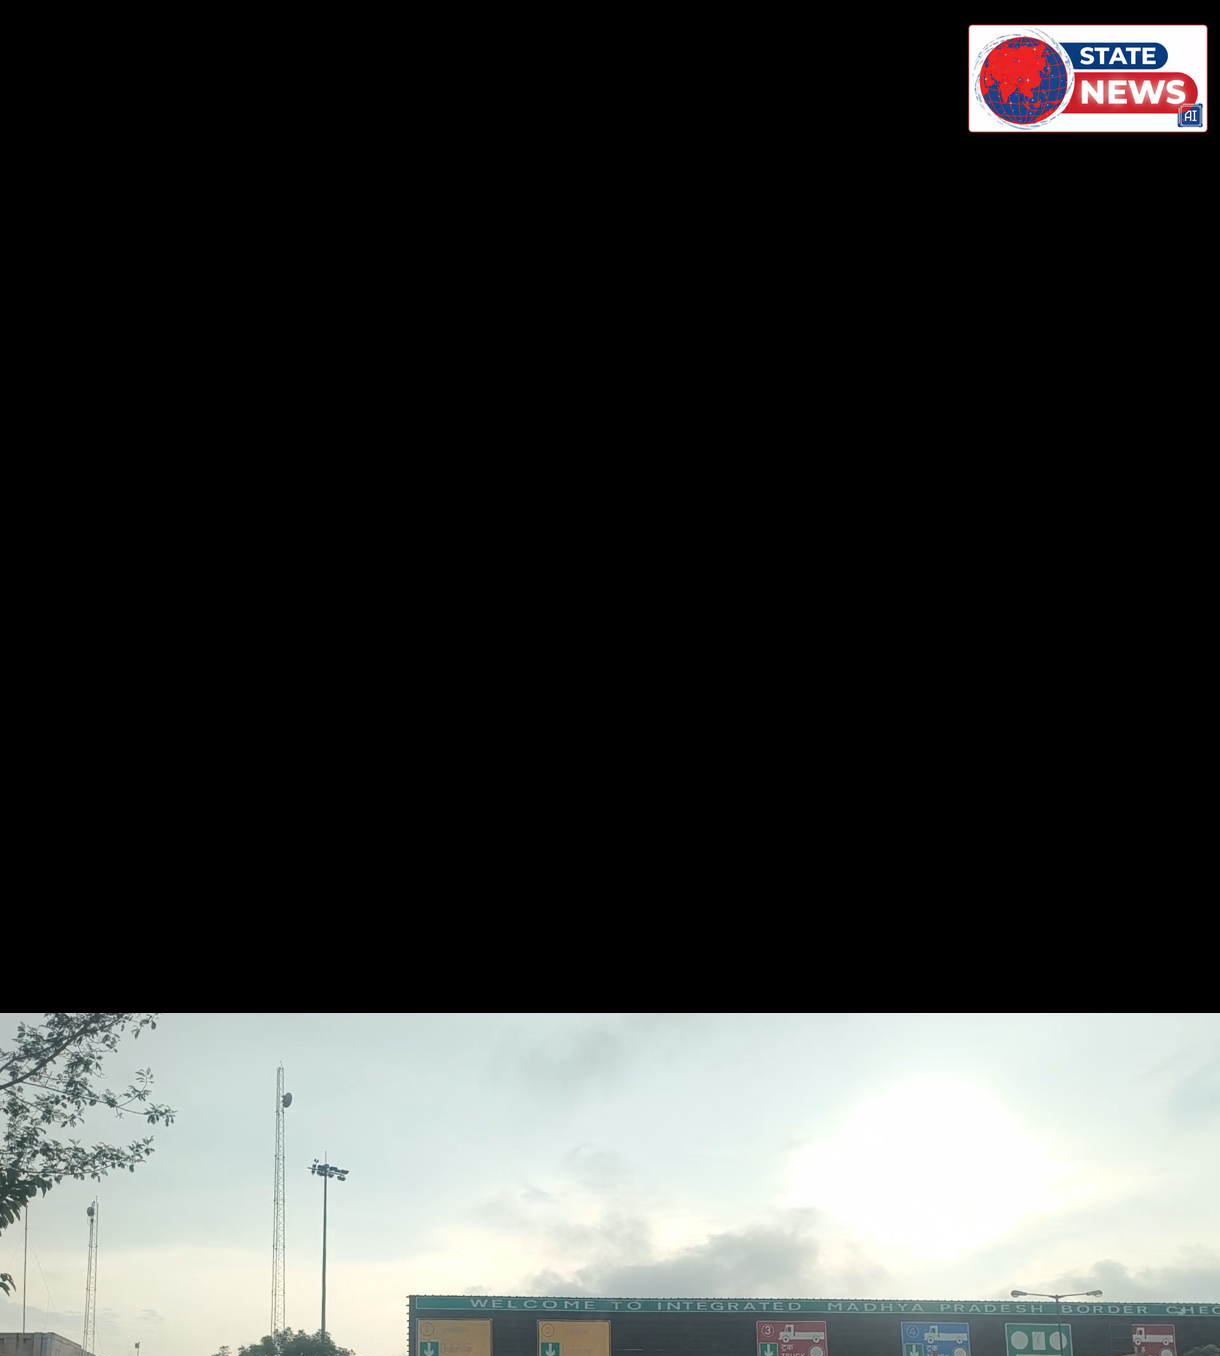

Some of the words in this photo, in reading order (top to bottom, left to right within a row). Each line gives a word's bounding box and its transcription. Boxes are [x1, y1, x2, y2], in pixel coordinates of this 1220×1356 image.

[470, 1299, 595, 1309] WELCOME
[611, 1301, 641, 1310] TO
[657, 1301, 801, 1311] INTEGRATED
[827, 1303, 924, 1312] MADHYA
[940, 1304, 1043, 1313] PRADESH
[1061, 1305, 1148, 1314] BORDER
[764, 1325, 771, 1335] 3
